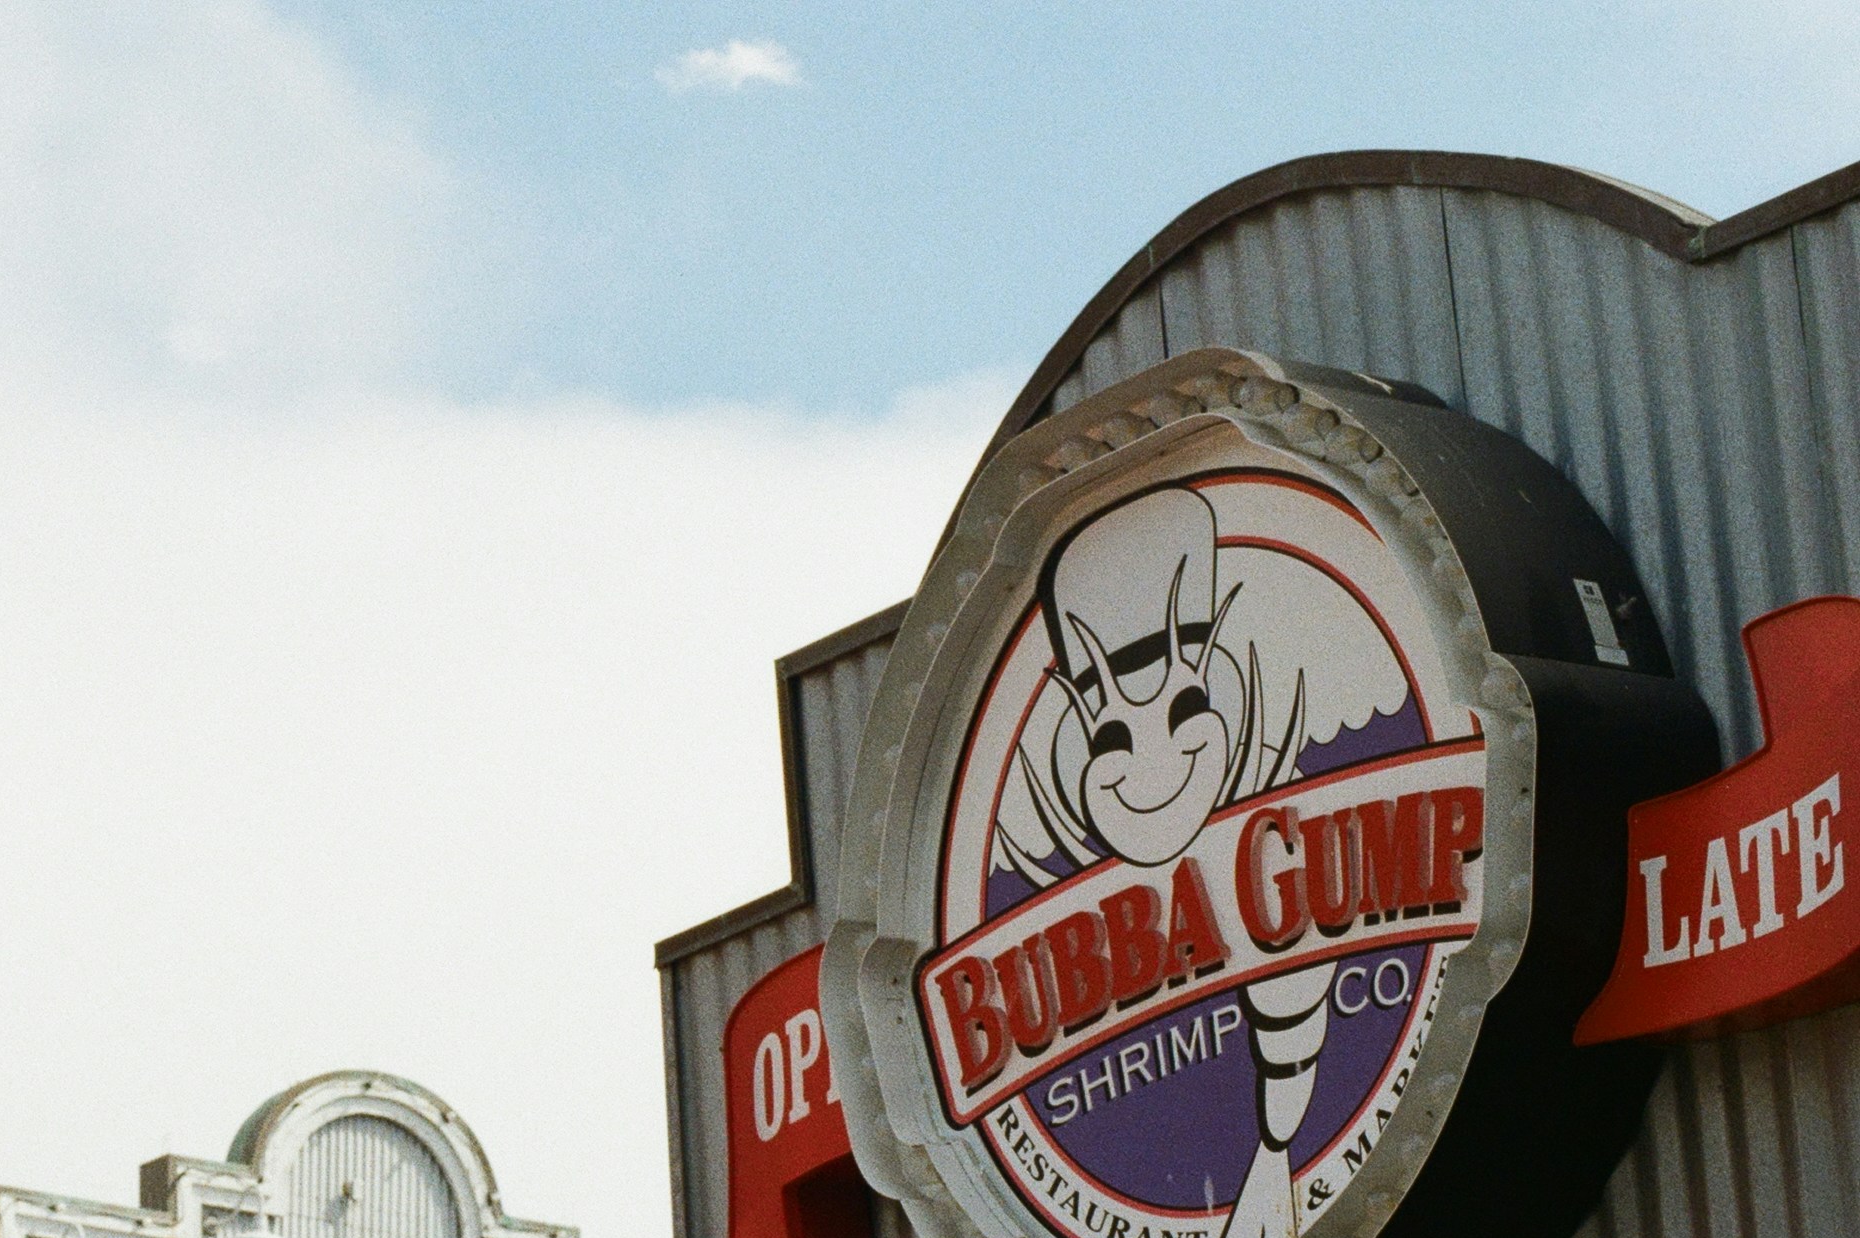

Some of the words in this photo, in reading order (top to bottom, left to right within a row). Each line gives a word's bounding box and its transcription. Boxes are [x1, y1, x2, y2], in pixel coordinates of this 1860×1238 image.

[934, 857, 1234, 1098] BUBBA
[1235, 786, 1485, 954] GUMP
[1639, 771, 1845, 969] LATE
[753, 1007, 842, 1142] OP
[1045, 1002, 1244, 1128] SHRIMP
[1333, 956, 1413, 1017] CO.
[1306, 1177, 1336, 1211] &
